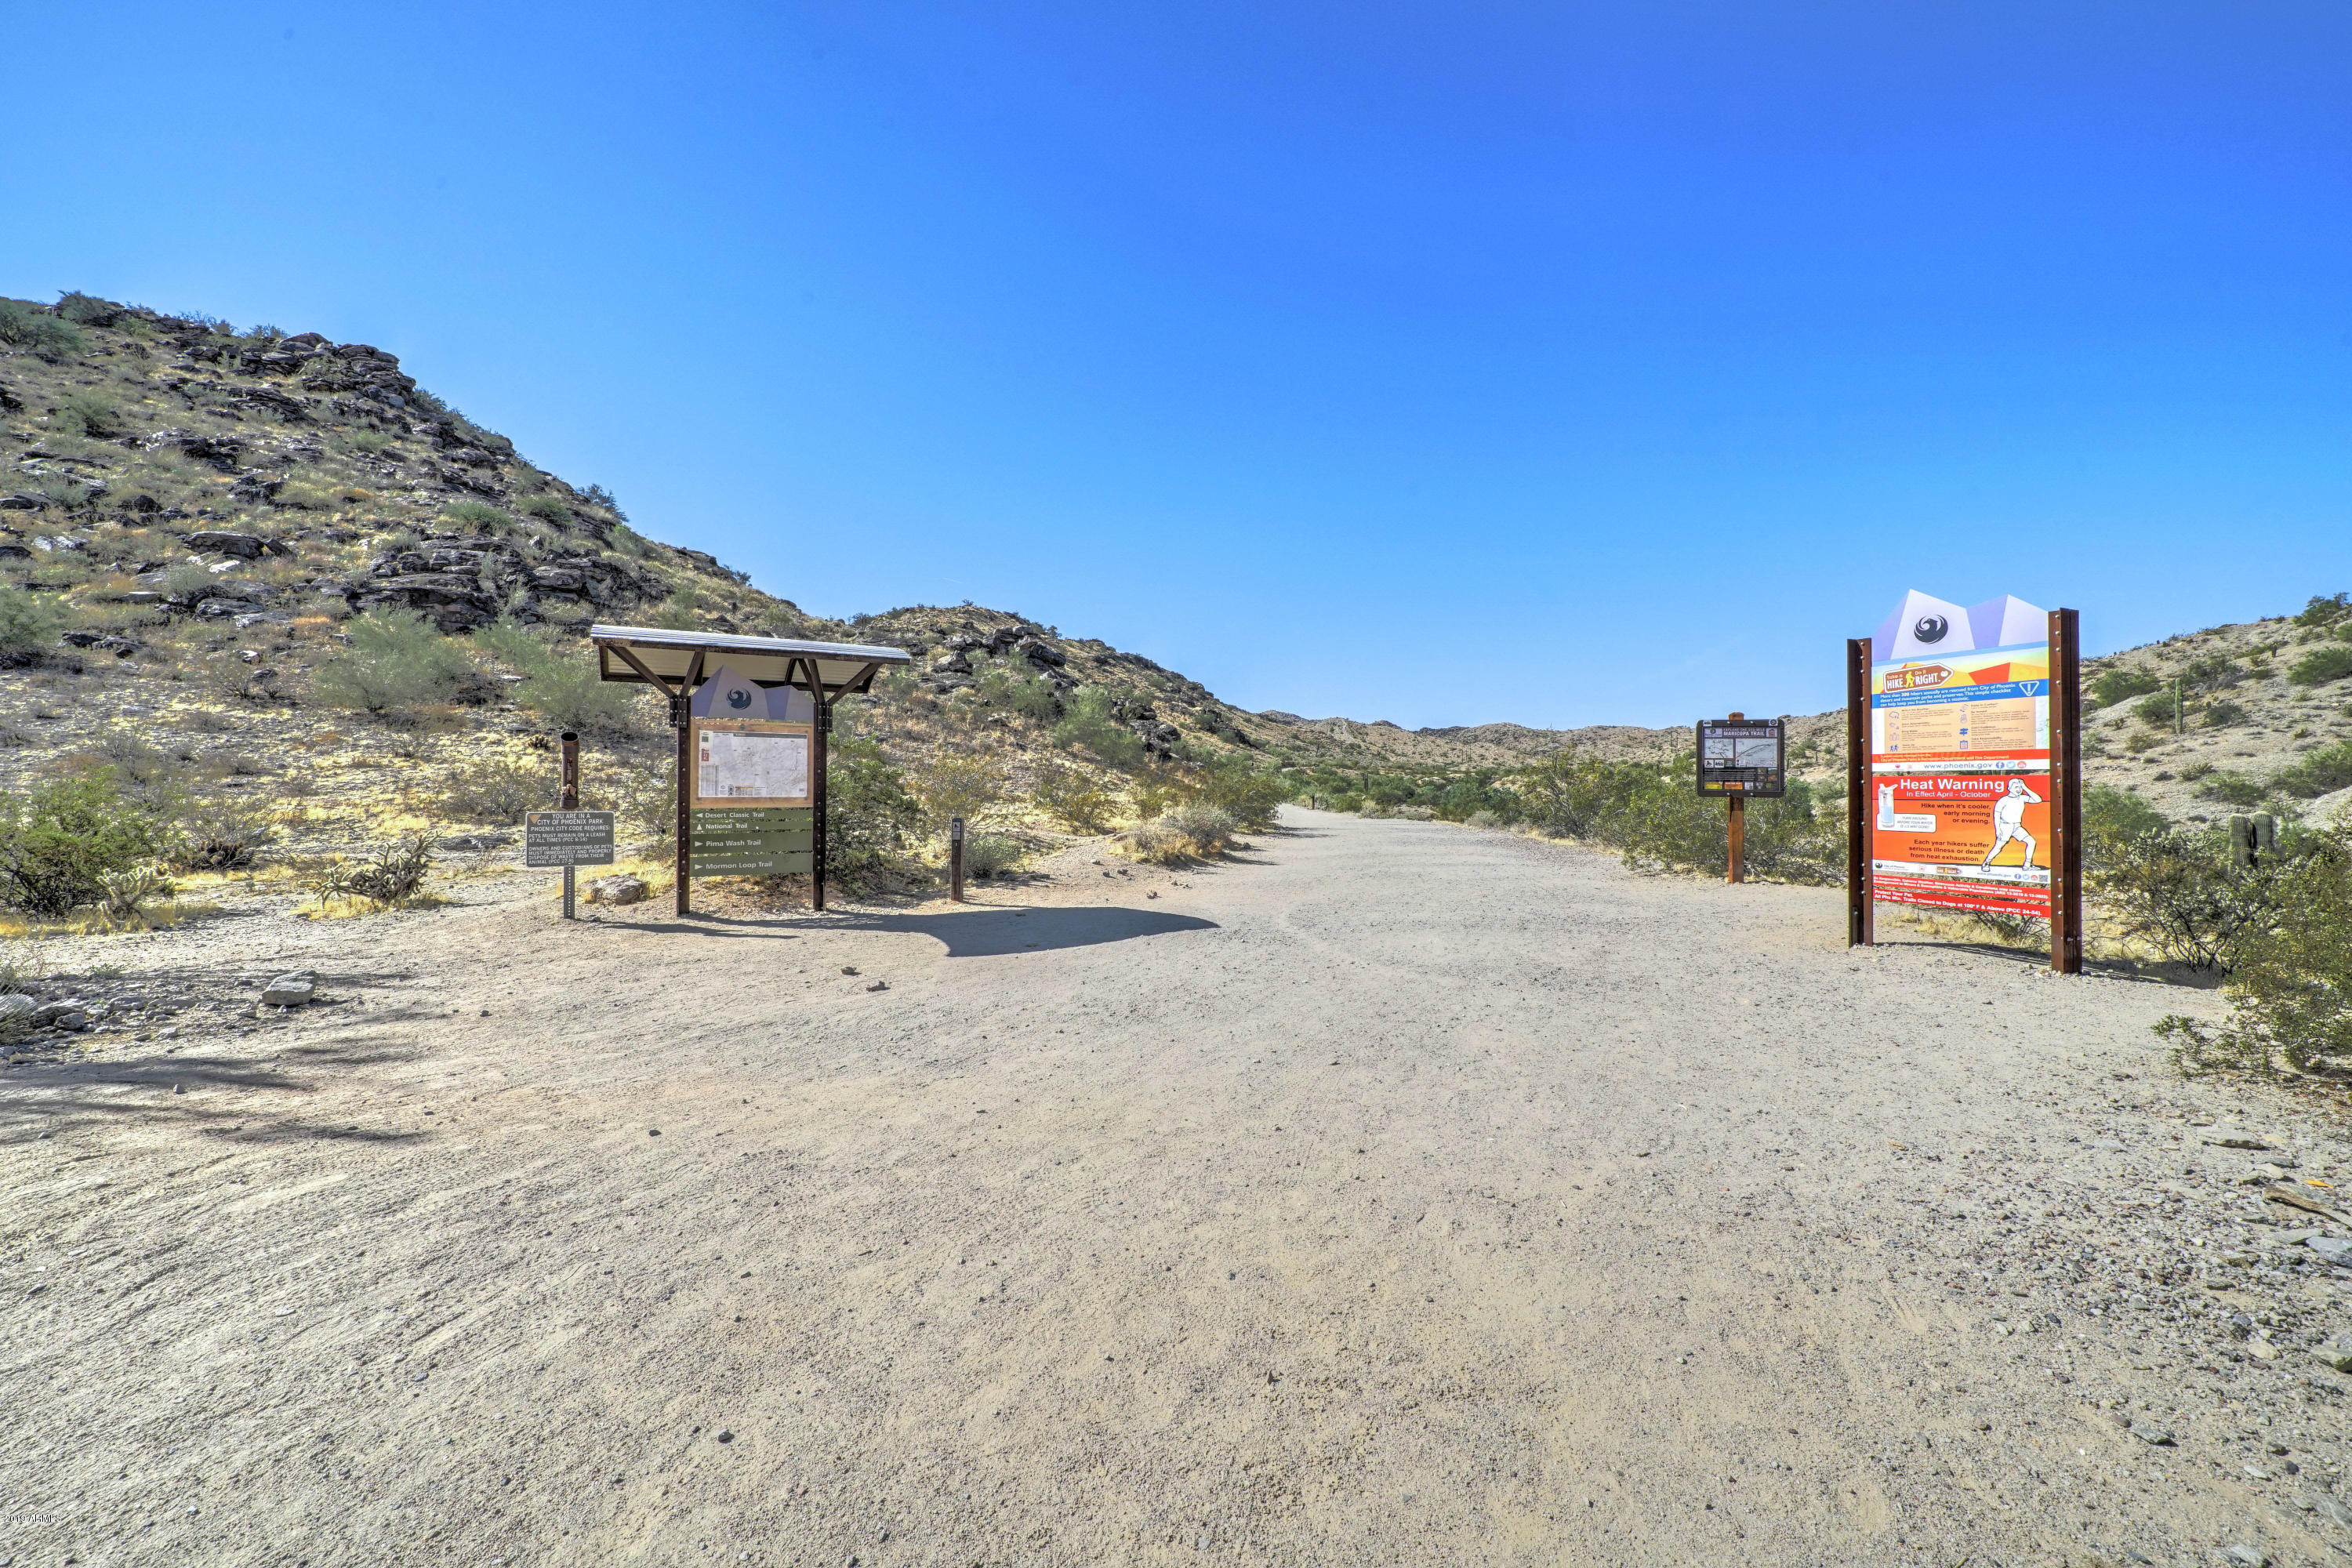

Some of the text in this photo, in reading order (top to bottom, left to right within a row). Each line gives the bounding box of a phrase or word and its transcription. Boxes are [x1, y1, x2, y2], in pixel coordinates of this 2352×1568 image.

[1915, 673, 1940, 685] RIGHT.
[1900, 779, 2004, 793] Heat Warning
